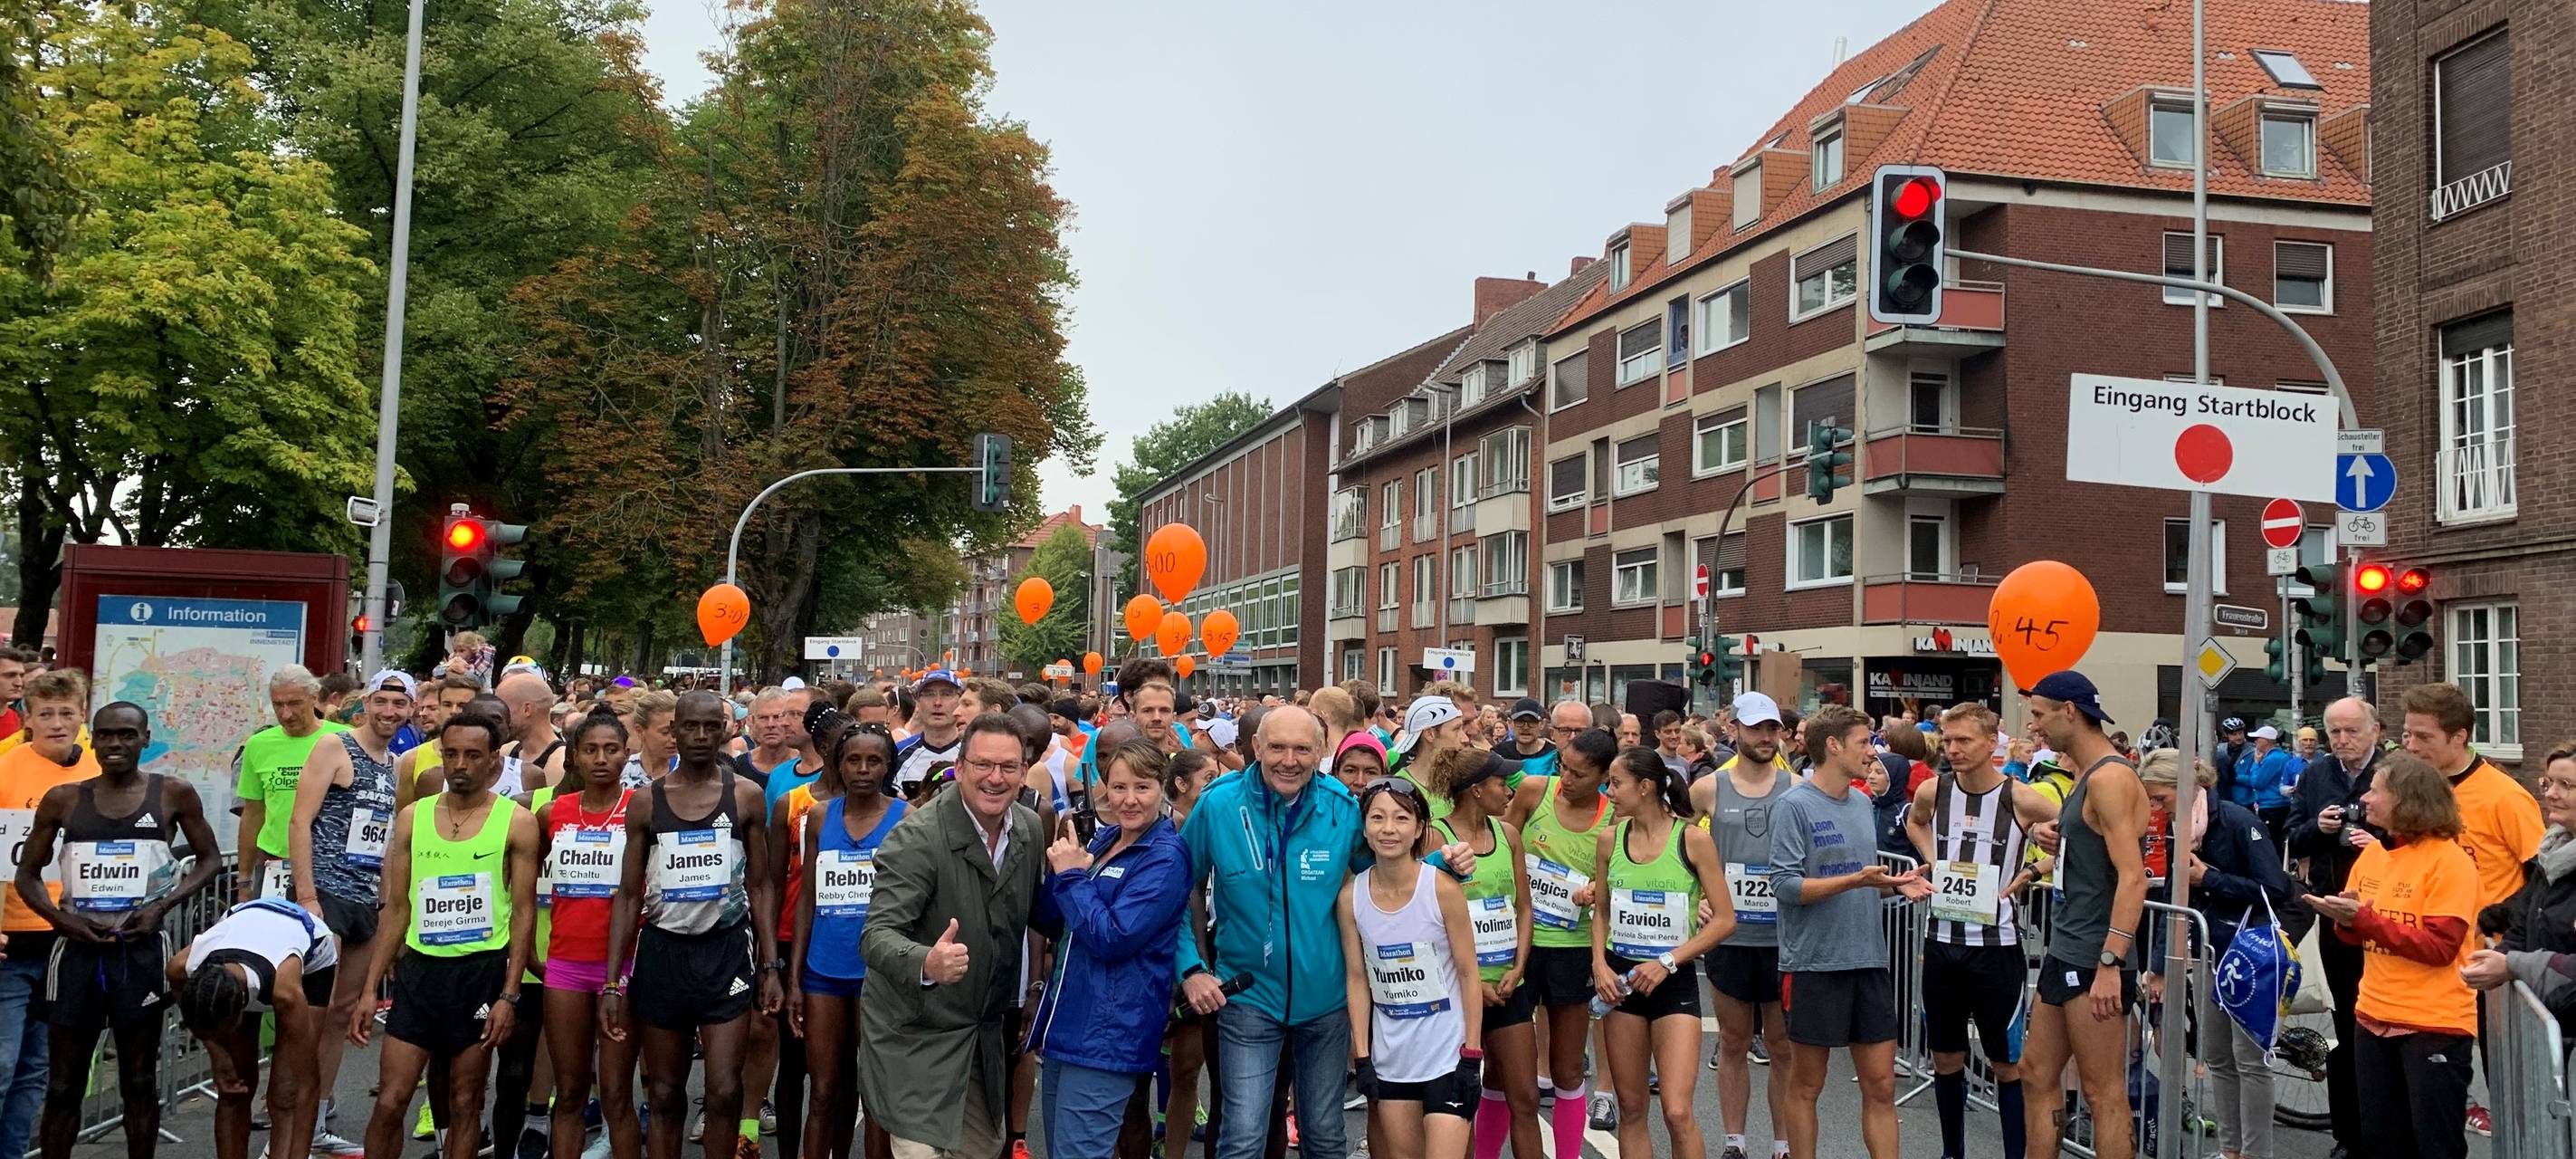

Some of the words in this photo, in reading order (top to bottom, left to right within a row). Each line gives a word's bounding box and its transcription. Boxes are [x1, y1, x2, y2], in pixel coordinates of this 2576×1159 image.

[2094, 386, 2187, 417] Eingang
[2197, 395, 2316, 423] Startblock
[2352, 443, 2365, 451] frei
[168, 607, 267, 623] Information
[1914, 627, 1998, 657] KAMINLAN
[360, 825, 386, 844] 964
[681, 835, 714, 843] Marathon
[559, 849, 614, 867] Chaltu
[666, 852, 723, 870] James
[80, 863, 139, 879] Edwin
[570, 870, 600, 879] Chaltu
[679, 873, 711, 883] James
[440, 878, 473, 886] Marathon
[825, 869, 877, 888] Rebby
[91, 884, 124, 893] Edwin
[1942, 876, 1977, 897] 245
[818, 892, 845, 901] Rebby
[1744, 899, 1770, 907] Marco
[1945, 896, 1971, 906] Robert
[425, 896, 483, 915] Dereje
[424, 918, 453, 928] Dereje
[455, 915, 486, 925] Girma
[1474, 918, 1513, 934] Yolimar
[1619, 910, 1672, 928] Faviola
[1613, 930, 1636, 939] Faviola
[1379, 949, 1412, 957] Marathon
[1372, 967, 1426, 984] Yumiko
[1384, 989, 1418, 1000] Yumiko
